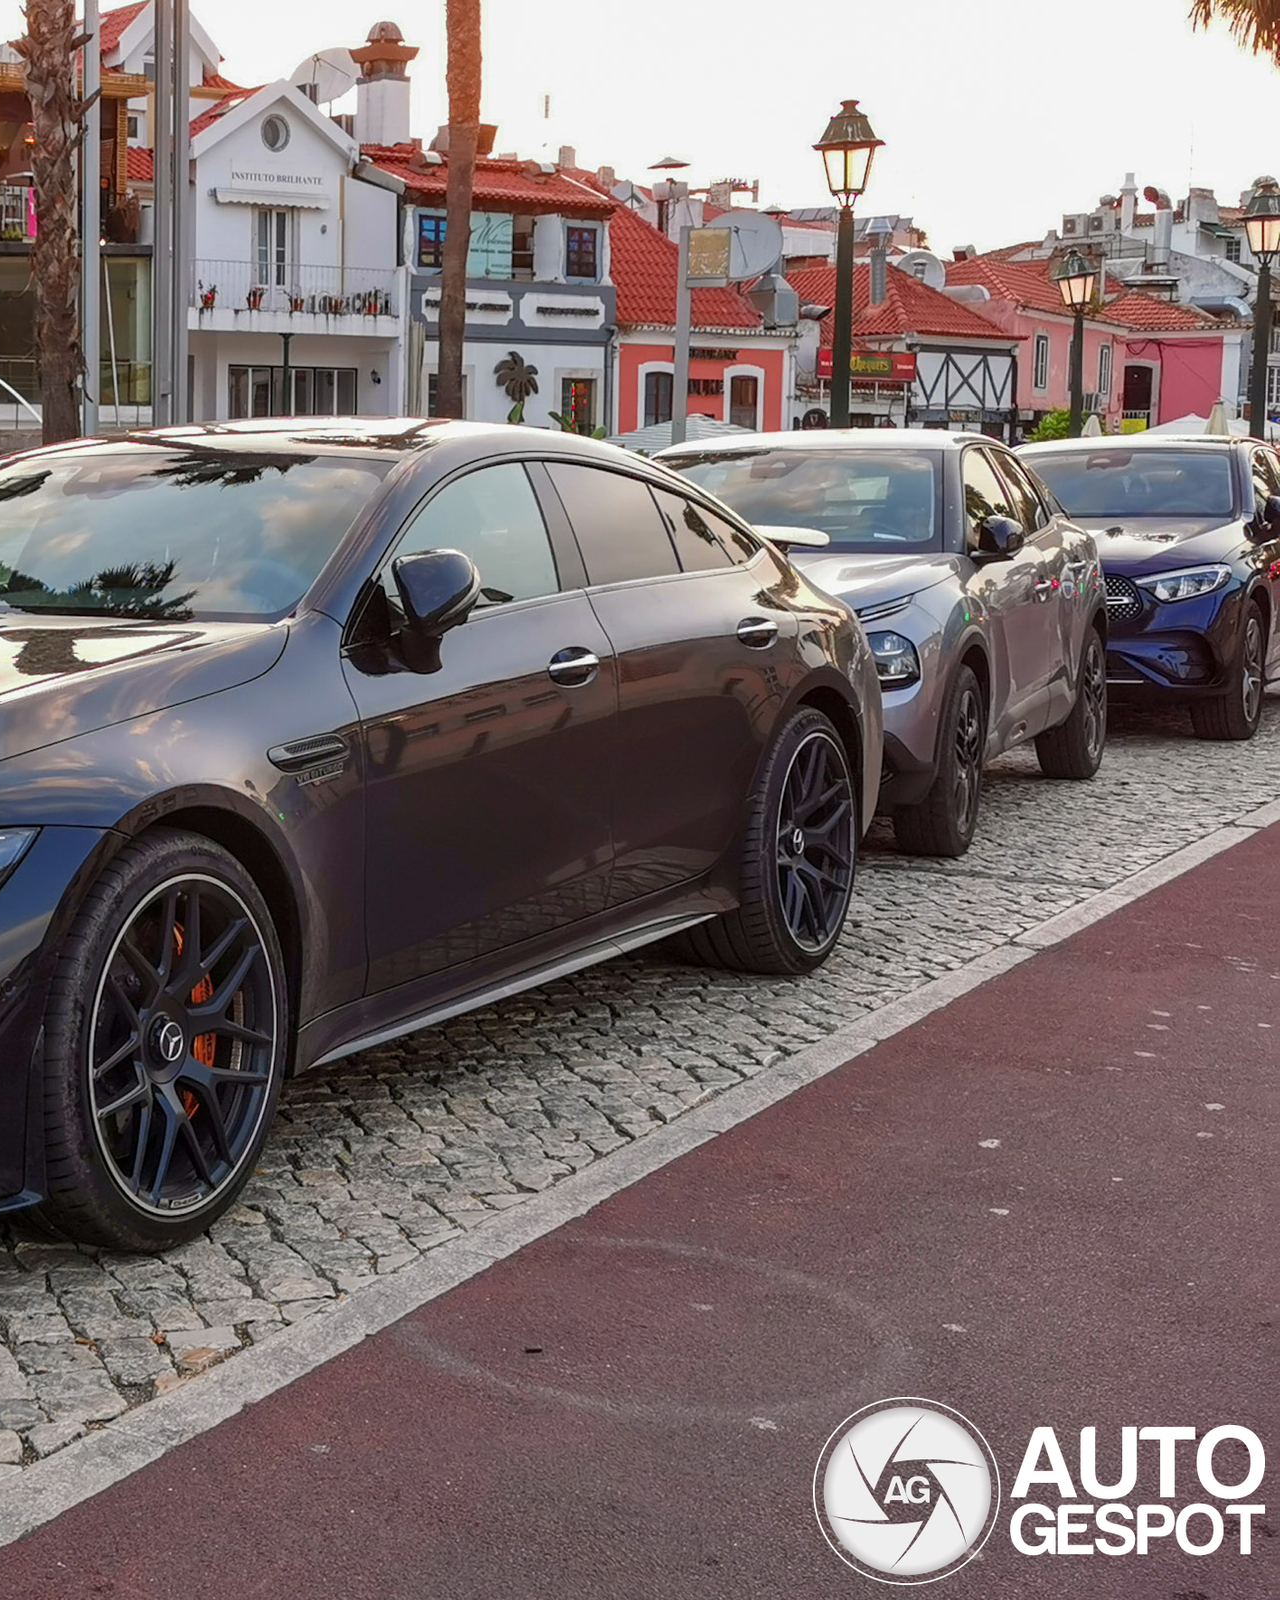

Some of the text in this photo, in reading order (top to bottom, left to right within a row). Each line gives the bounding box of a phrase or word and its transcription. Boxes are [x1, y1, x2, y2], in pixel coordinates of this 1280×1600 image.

[231, 171, 324, 186] INSTITUTO BRILHANTE
[850, 356, 889, 373] Chequers
